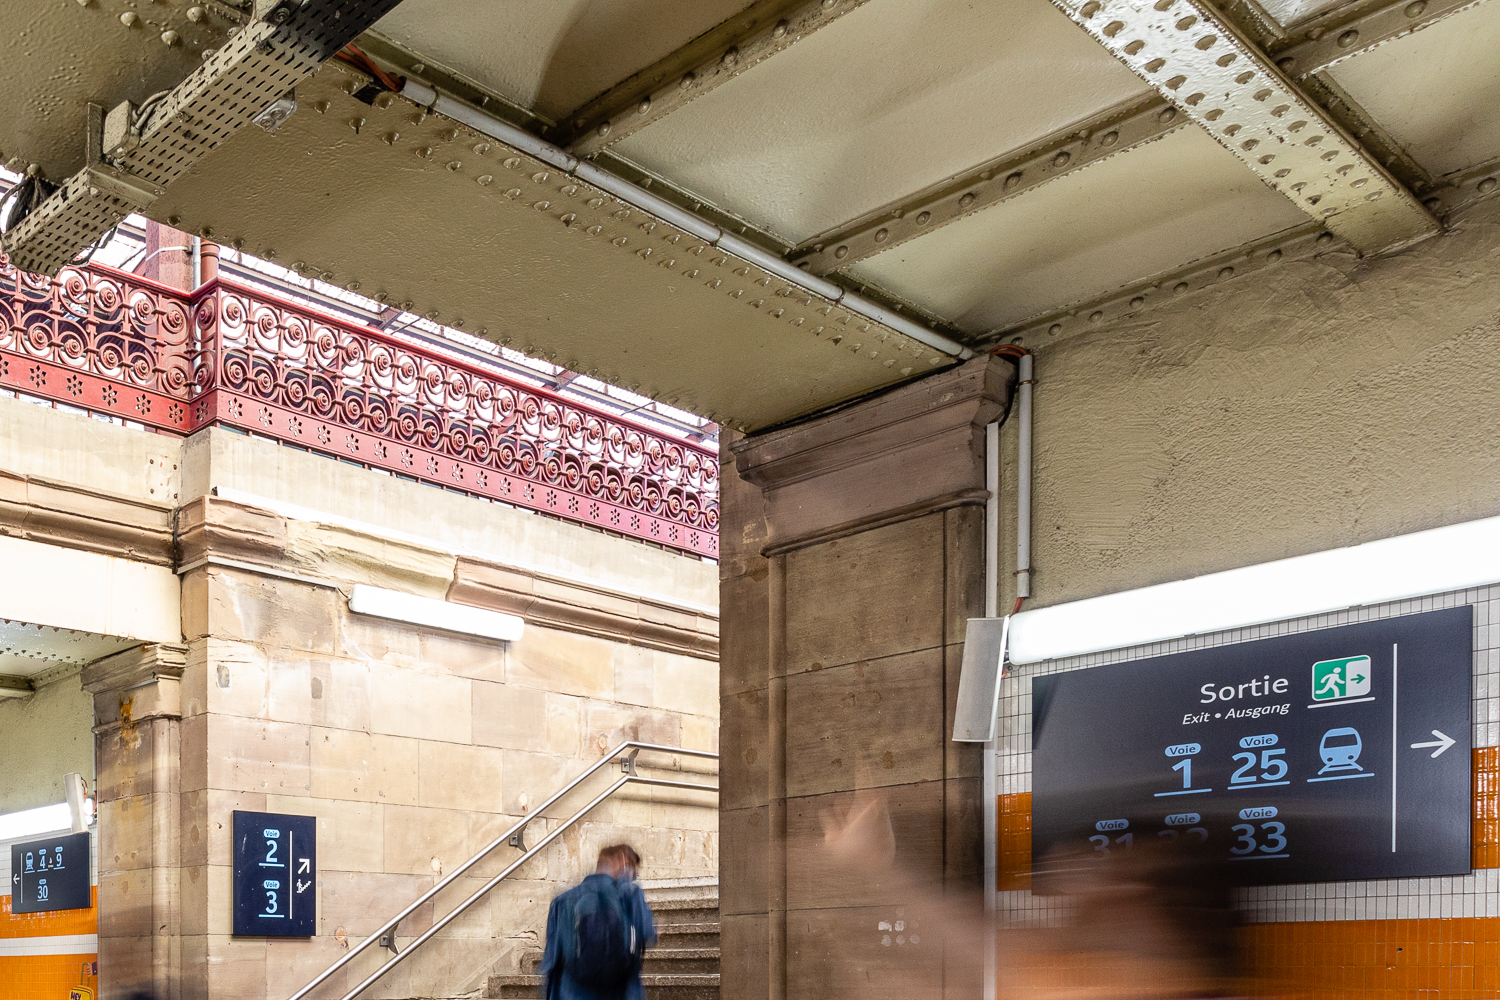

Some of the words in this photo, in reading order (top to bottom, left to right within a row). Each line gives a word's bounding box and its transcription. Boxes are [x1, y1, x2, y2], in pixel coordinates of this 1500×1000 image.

[1200, 675, 1288, 704] Sortie
[1182, 712, 1210, 725] Exit
[1225, 703, 1290, 720] Ausgang
[1244, 736, 1273, 746] Voie
[1170, 746, 1196, 756] Voie
[1172, 759, 1192, 788] 1
[1230, 748, 1288, 784] 25
[1170, 814, 1196, 824] Voie
[1244, 808, 1272, 818] Voie
[1100, 820, 1124, 830] Voie
[1229, 822, 1288, 854] 33
[266, 840, 278, 862] 2
[40, 856, 46, 868] 4
[56, 853, 62, 866] 9
[38, 885, 48, 898] 30
[266, 890, 278, 914] 3
